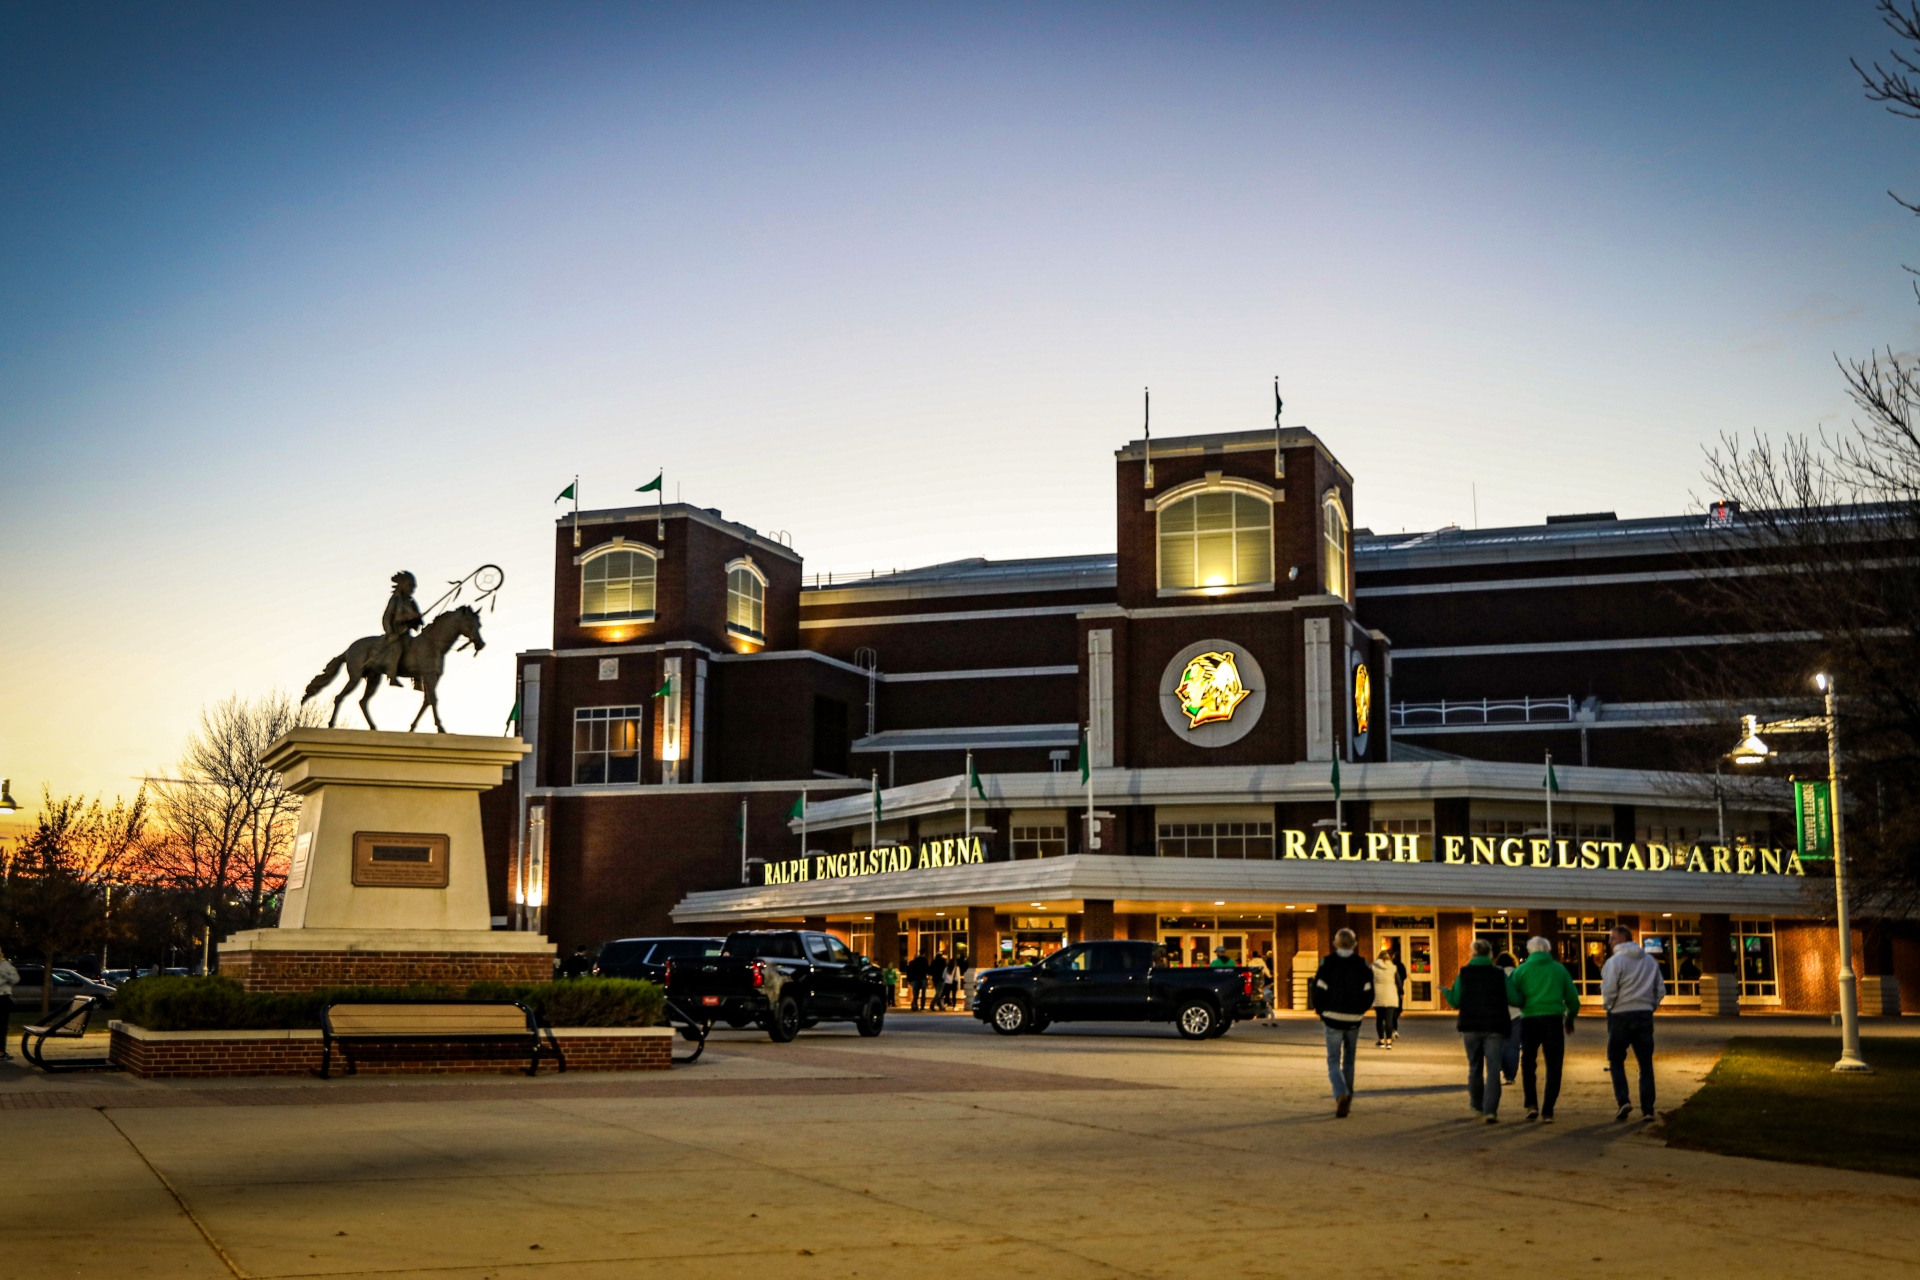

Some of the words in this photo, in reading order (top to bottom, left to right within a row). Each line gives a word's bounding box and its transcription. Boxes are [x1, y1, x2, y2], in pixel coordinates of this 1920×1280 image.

[1802, 784, 1815, 815] NORTH
[763, 858, 809, 886] RALPH
[816, 845, 912, 881] ENGELSTAD
[917, 836, 984, 870] ARENA
[1282, 829, 1421, 863] RALPH
[1442, 835, 1672, 871] ENGELSTAD
[1686, 844, 1806, 876] ARENA
[278, 962, 343, 979] RALPH
[353, 962, 462, 979] ENGELSTAD
[472, 963, 531, 979] ARENA
